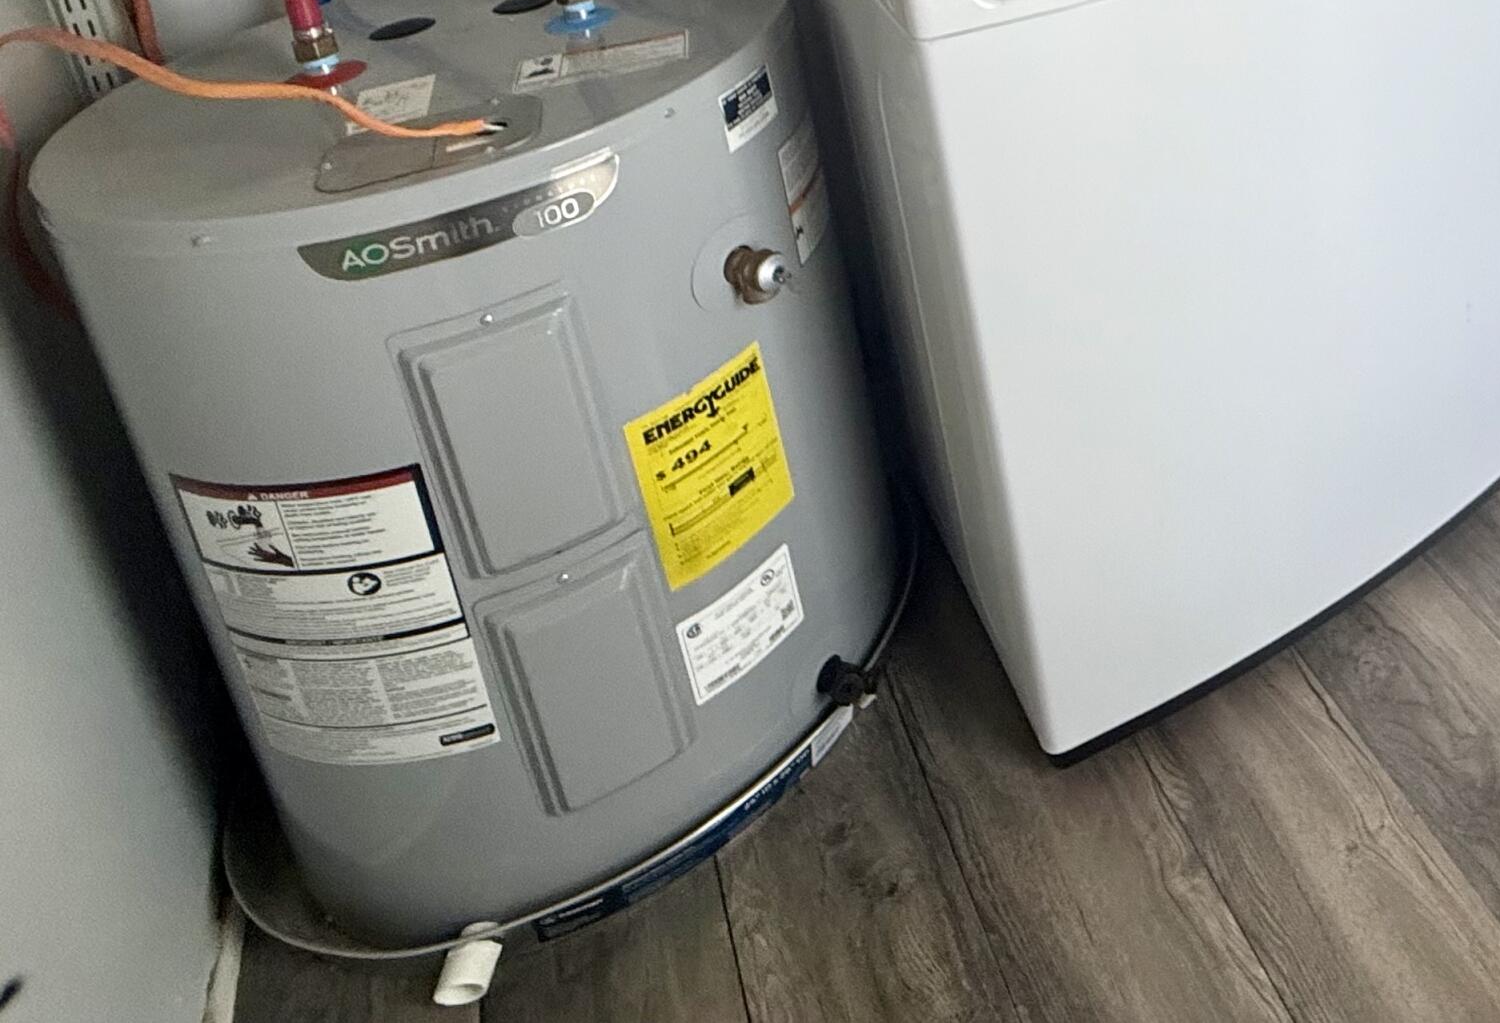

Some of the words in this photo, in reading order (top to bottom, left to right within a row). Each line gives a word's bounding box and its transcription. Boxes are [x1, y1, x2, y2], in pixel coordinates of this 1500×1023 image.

[536, 197, 580, 228] 100
[671, 439, 712, 472] 494
[260, 490, 310, 502] DANGER
